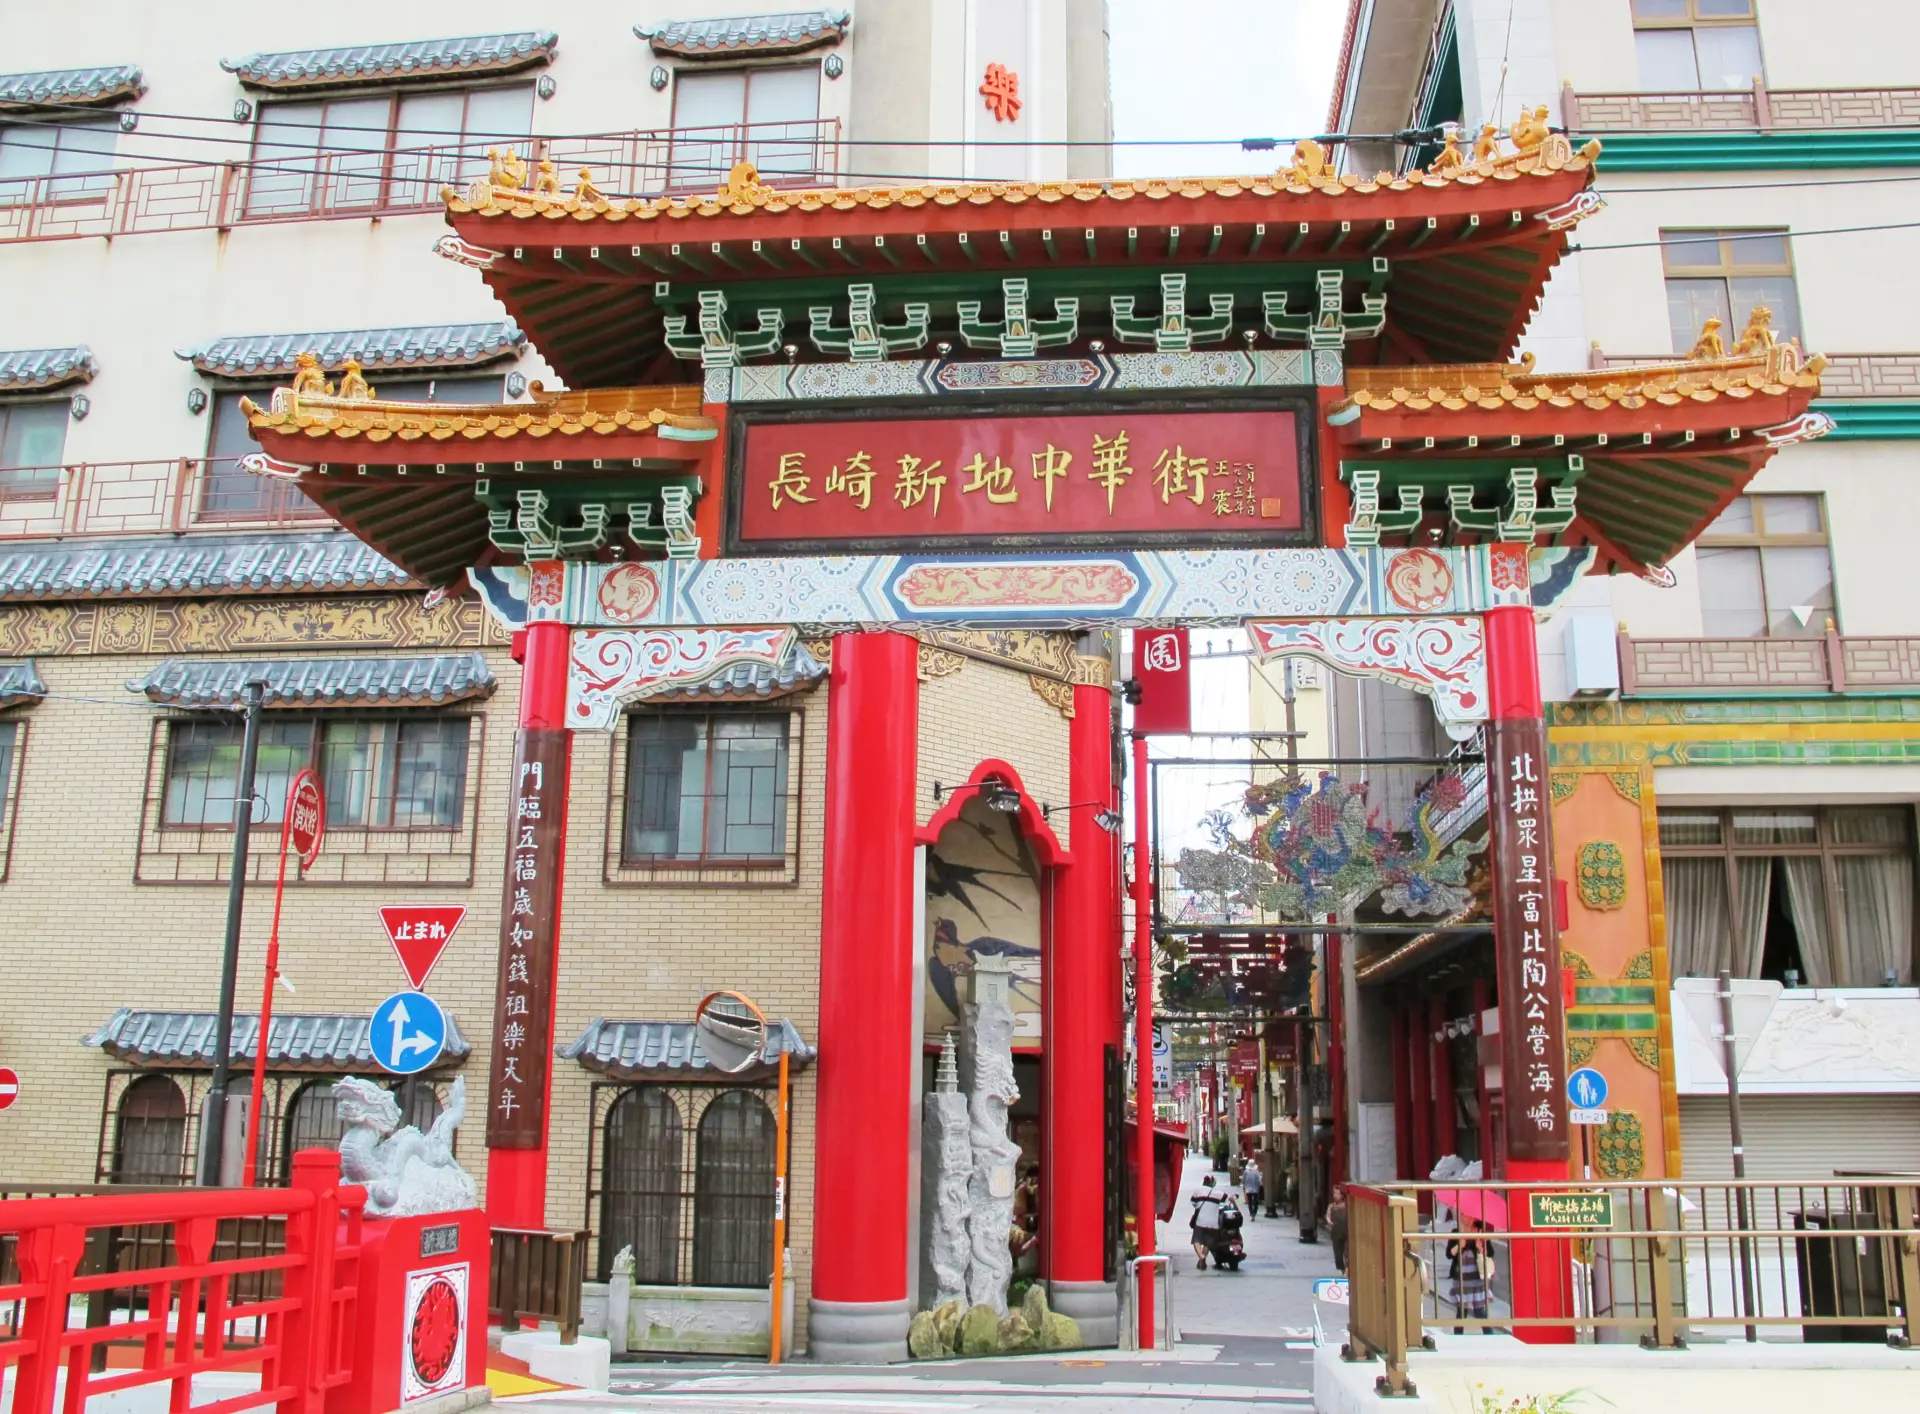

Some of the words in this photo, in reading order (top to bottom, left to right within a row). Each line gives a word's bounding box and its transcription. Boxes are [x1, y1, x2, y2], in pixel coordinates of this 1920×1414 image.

[769, 430, 1209, 517] 長崎新地中華街
[1212, 460, 1233, 516] 王震
[294, 803, 317, 836] 消火栓
[394, 920, 447, 940] 止まれ
[1539, 1196, 1604, 1216] 新地橋広場
